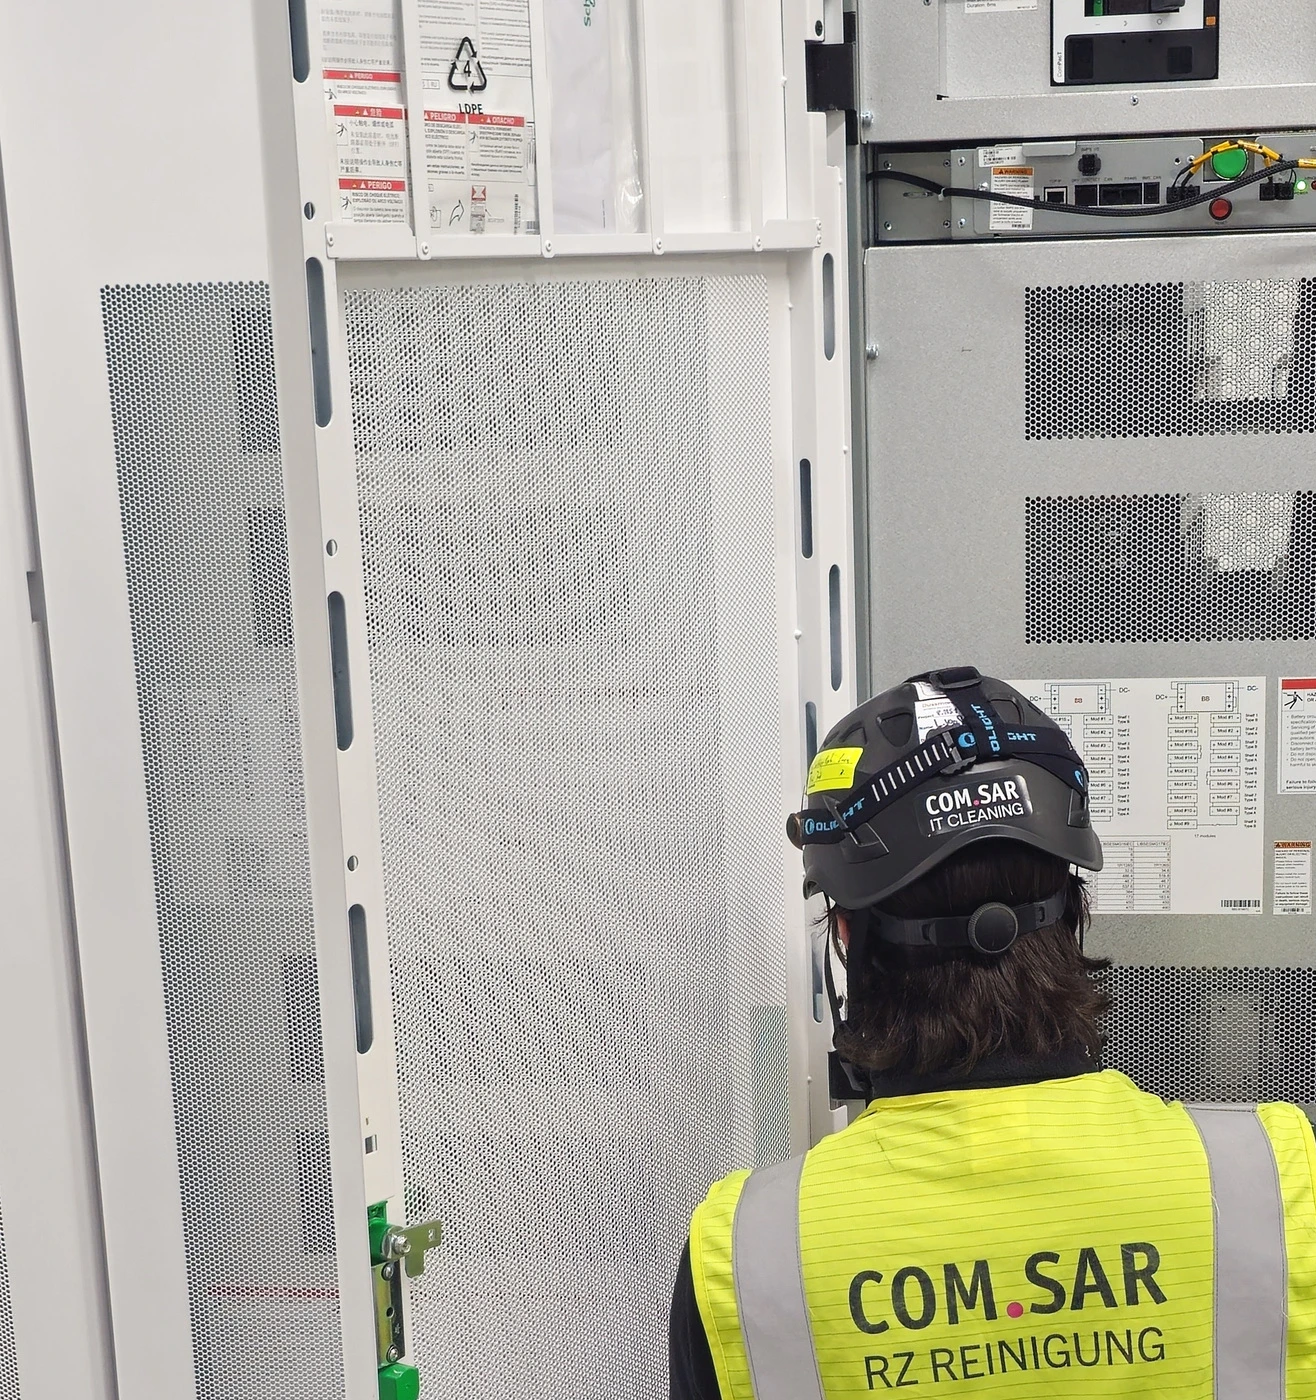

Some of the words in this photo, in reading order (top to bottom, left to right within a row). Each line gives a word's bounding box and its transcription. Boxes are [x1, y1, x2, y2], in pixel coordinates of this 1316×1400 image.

[463, 60, 472, 77] 4
[429, 112, 457, 122] PELIGRO
[458, 103, 484, 115] LDPE
[367, 181, 392, 190] PERIGO
[971, 703, 1001, 752] OLIGHT
[925, 781, 1020, 816] COM.SAR
[929, 817, 944, 832] IT
[946, 803, 1024, 828] CLEANING
[847, 1240, 1168, 1335] COM.SAR
[864, 1351, 919, 1390] RZ
[930, 1326, 1166, 1383] REINIGUNG
